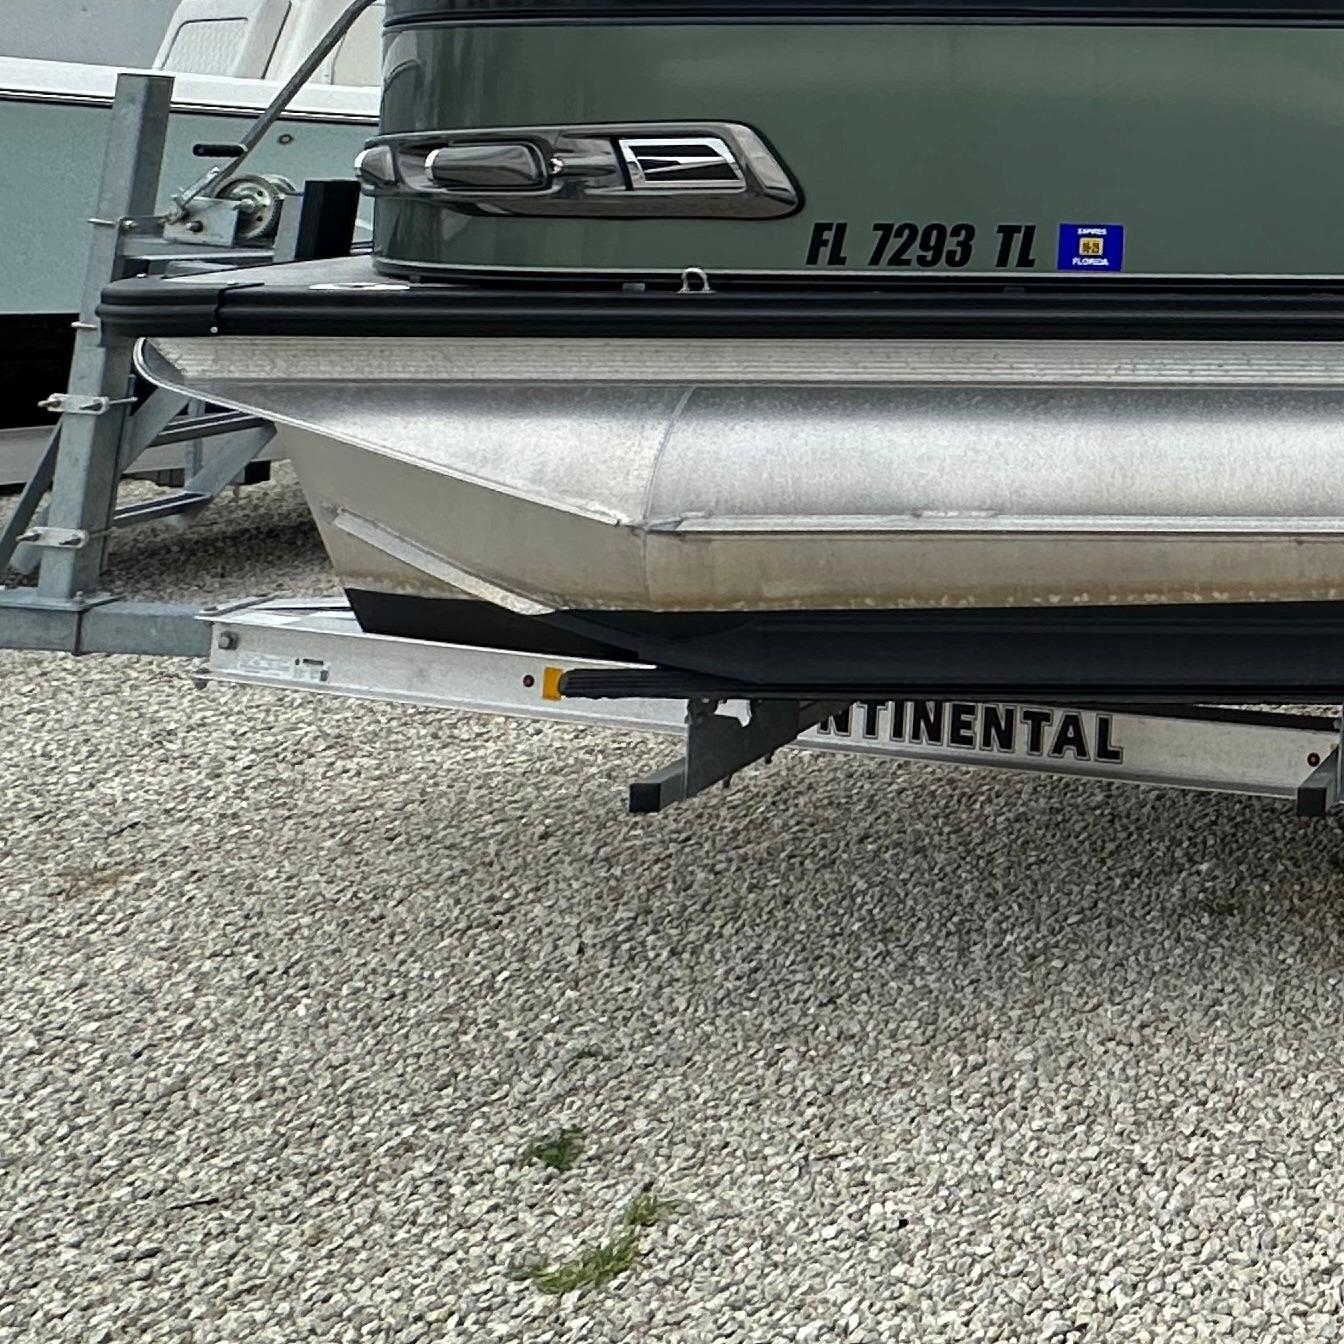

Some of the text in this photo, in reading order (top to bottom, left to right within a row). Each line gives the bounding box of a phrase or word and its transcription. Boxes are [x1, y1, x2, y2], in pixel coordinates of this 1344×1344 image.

[806, 222, 1037, 268] FL 7293 TL
